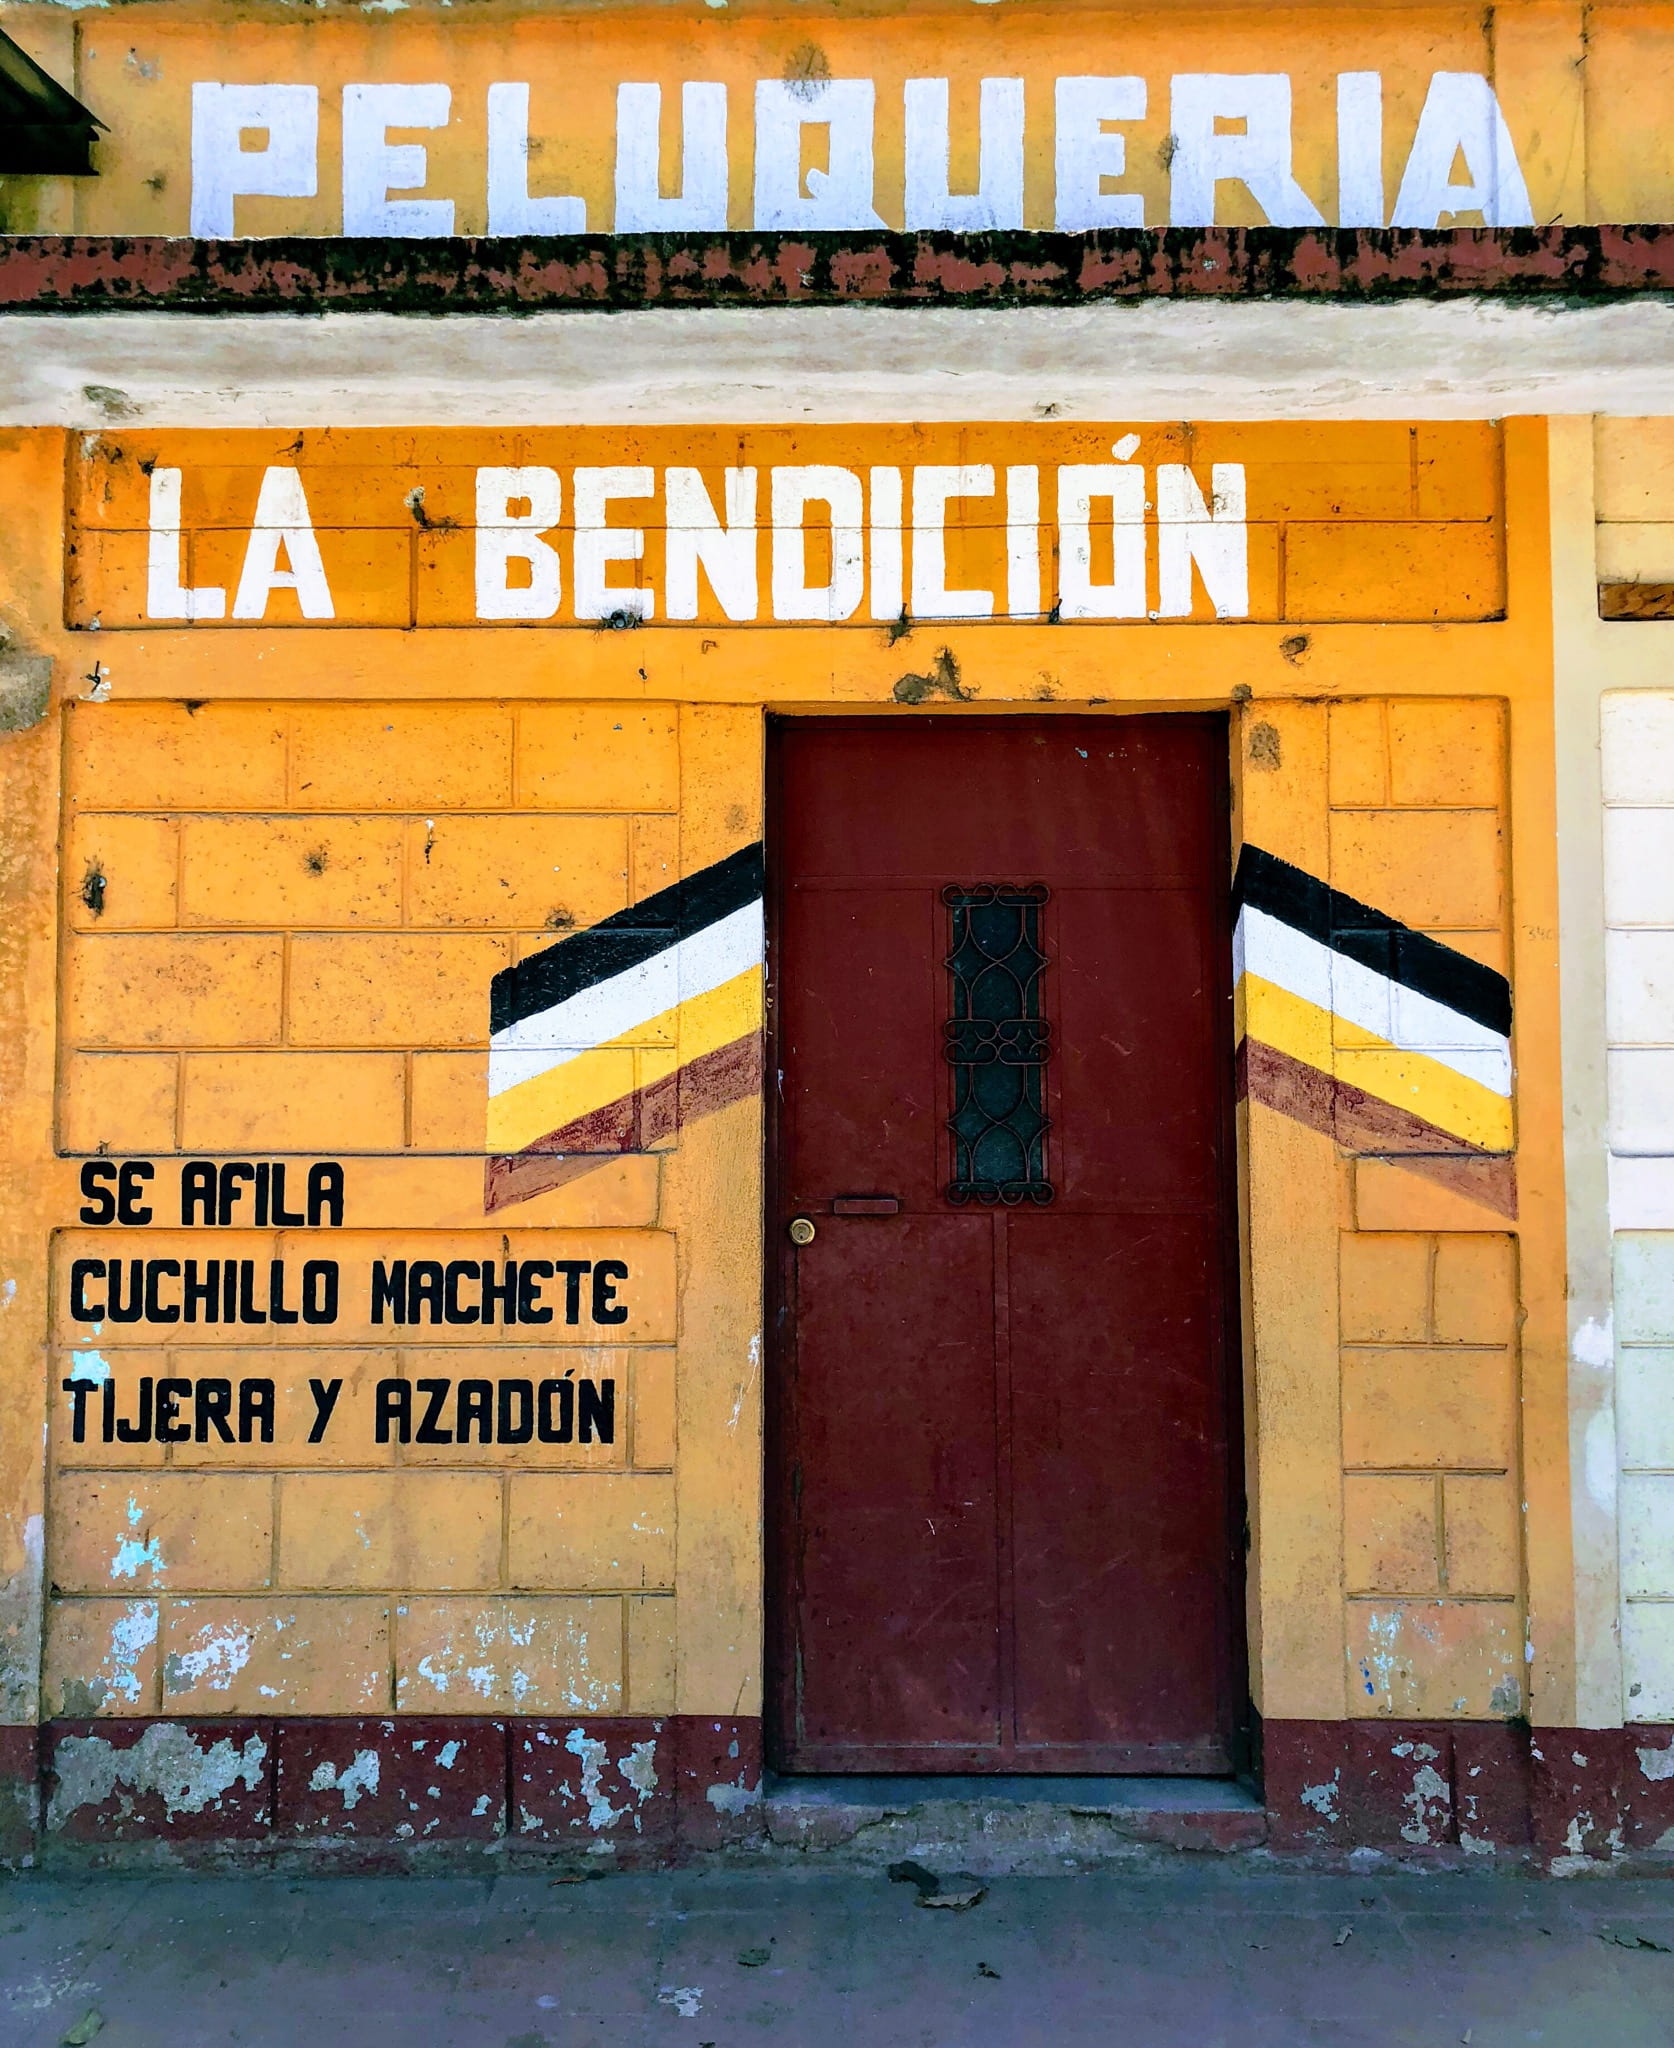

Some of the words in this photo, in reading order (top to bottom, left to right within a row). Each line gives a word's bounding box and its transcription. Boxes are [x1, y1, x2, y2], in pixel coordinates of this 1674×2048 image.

[189, 71, 1537, 240] PELUQUERIA
[146, 466, 335, 620] LA
[474, 433, 1249, 621] BENDICIÓN
[80, 1160, 154, 1226] SE
[181, 1161, 344, 1227] AFILA
[70, 1258, 339, 1325] CUCHILLO
[370, 1259, 629, 1325] MACHETE
[62, 1376, 275, 1444] TIJERA
[307, 1378, 343, 1444] Y
[375, 1368, 615, 1445] AZADÓN
